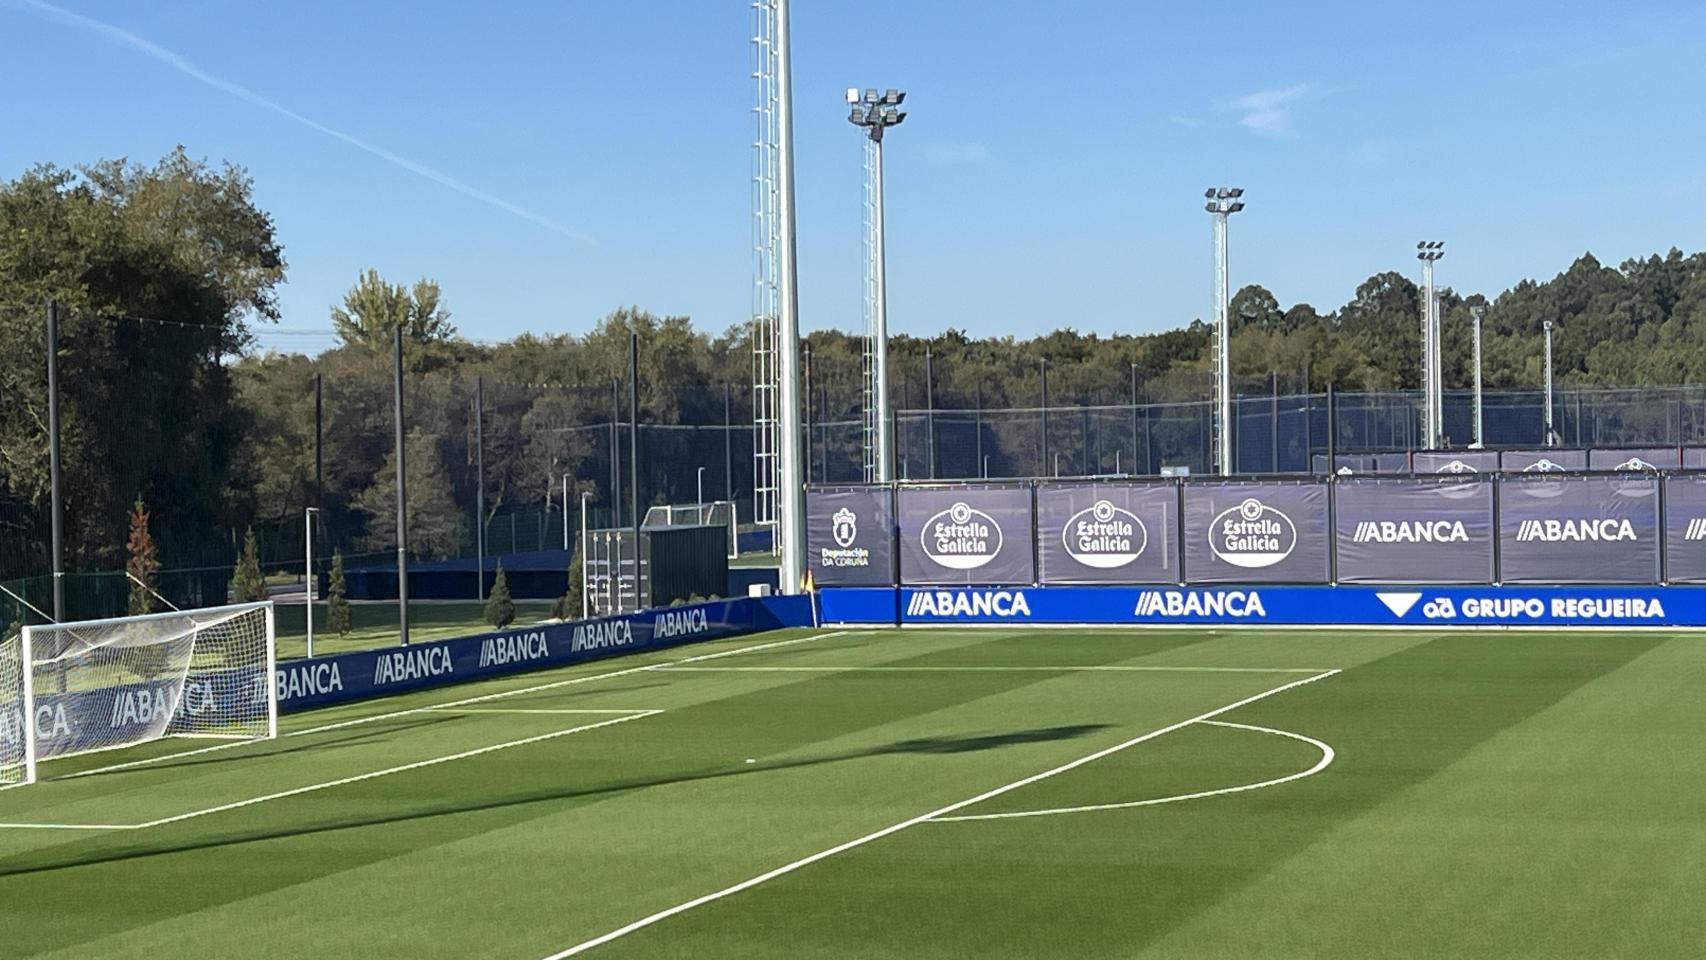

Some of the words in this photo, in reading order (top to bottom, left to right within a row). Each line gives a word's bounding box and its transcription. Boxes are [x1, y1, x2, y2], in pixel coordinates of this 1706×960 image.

[933, 522, 989, 538] Estrella
[1076, 520, 1133, 537] Estrella
[1222, 519, 1282, 536] Estrella
[936, 538, 987, 555] Galicia
[1078, 536, 1131, 553] Galicia
[1225, 534, 1280, 552] Galicia
[1461, 598, 1545, 618] GRUPO
[1551, 598, 1666, 618] REGUEIRA
[264, 661, 343, 702] BANCA
